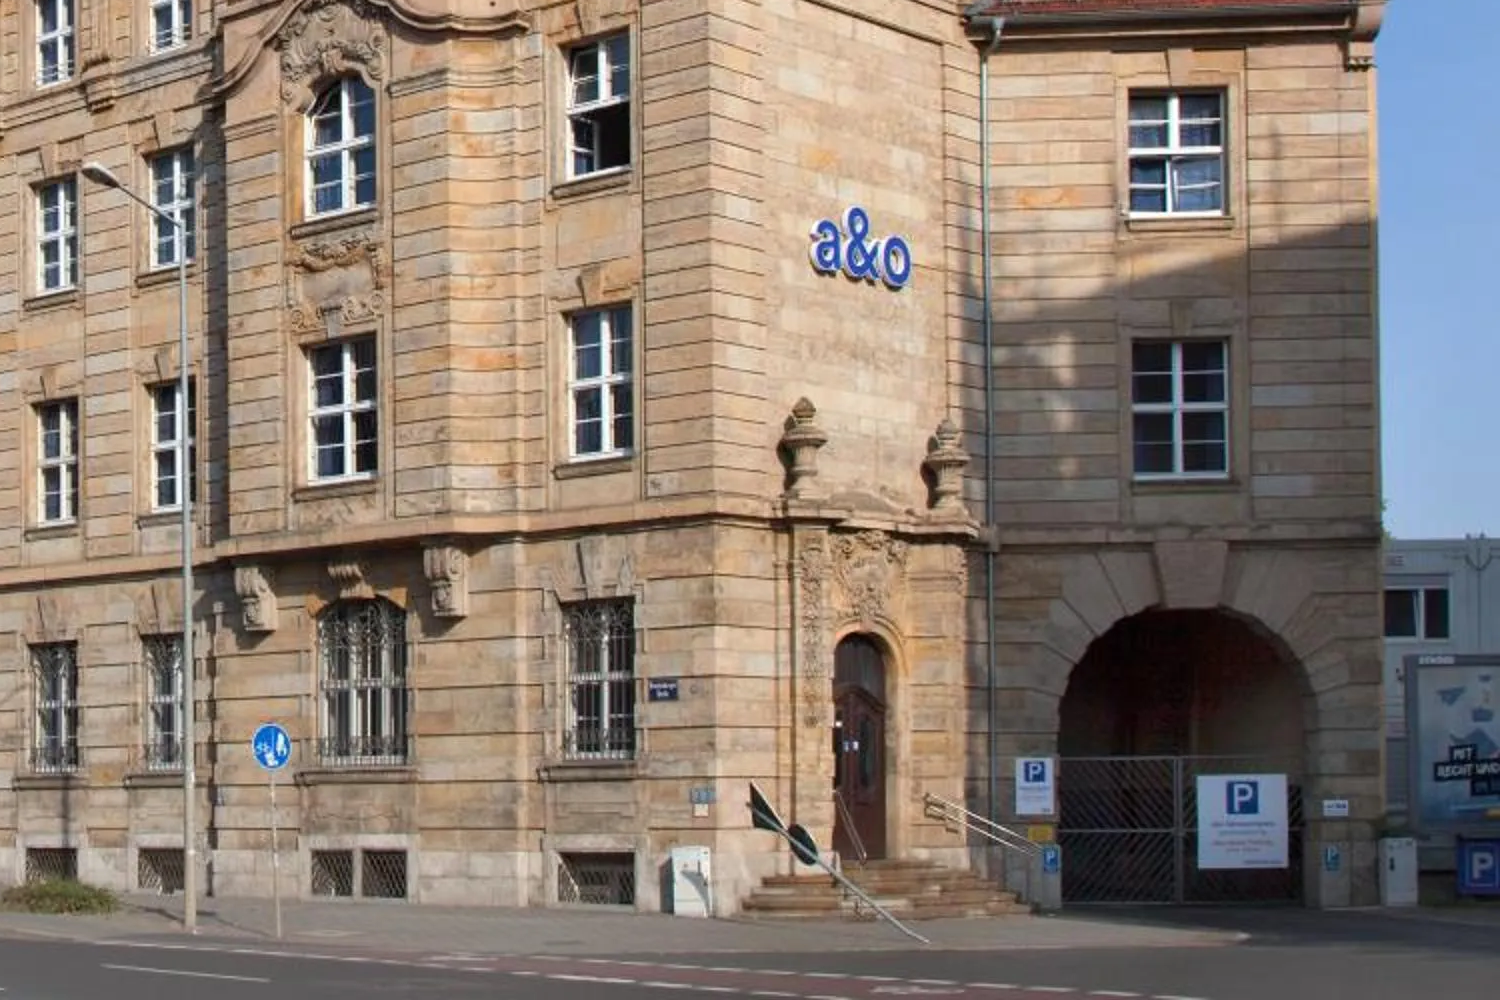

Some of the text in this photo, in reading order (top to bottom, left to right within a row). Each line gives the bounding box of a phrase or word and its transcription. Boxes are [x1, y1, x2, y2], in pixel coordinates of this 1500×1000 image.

[810, 207, 911, 285] a&o
[1028, 763, 1042, 782] P
[1233, 783, 1253, 812] P
[1471, 851, 1494, 879] P
